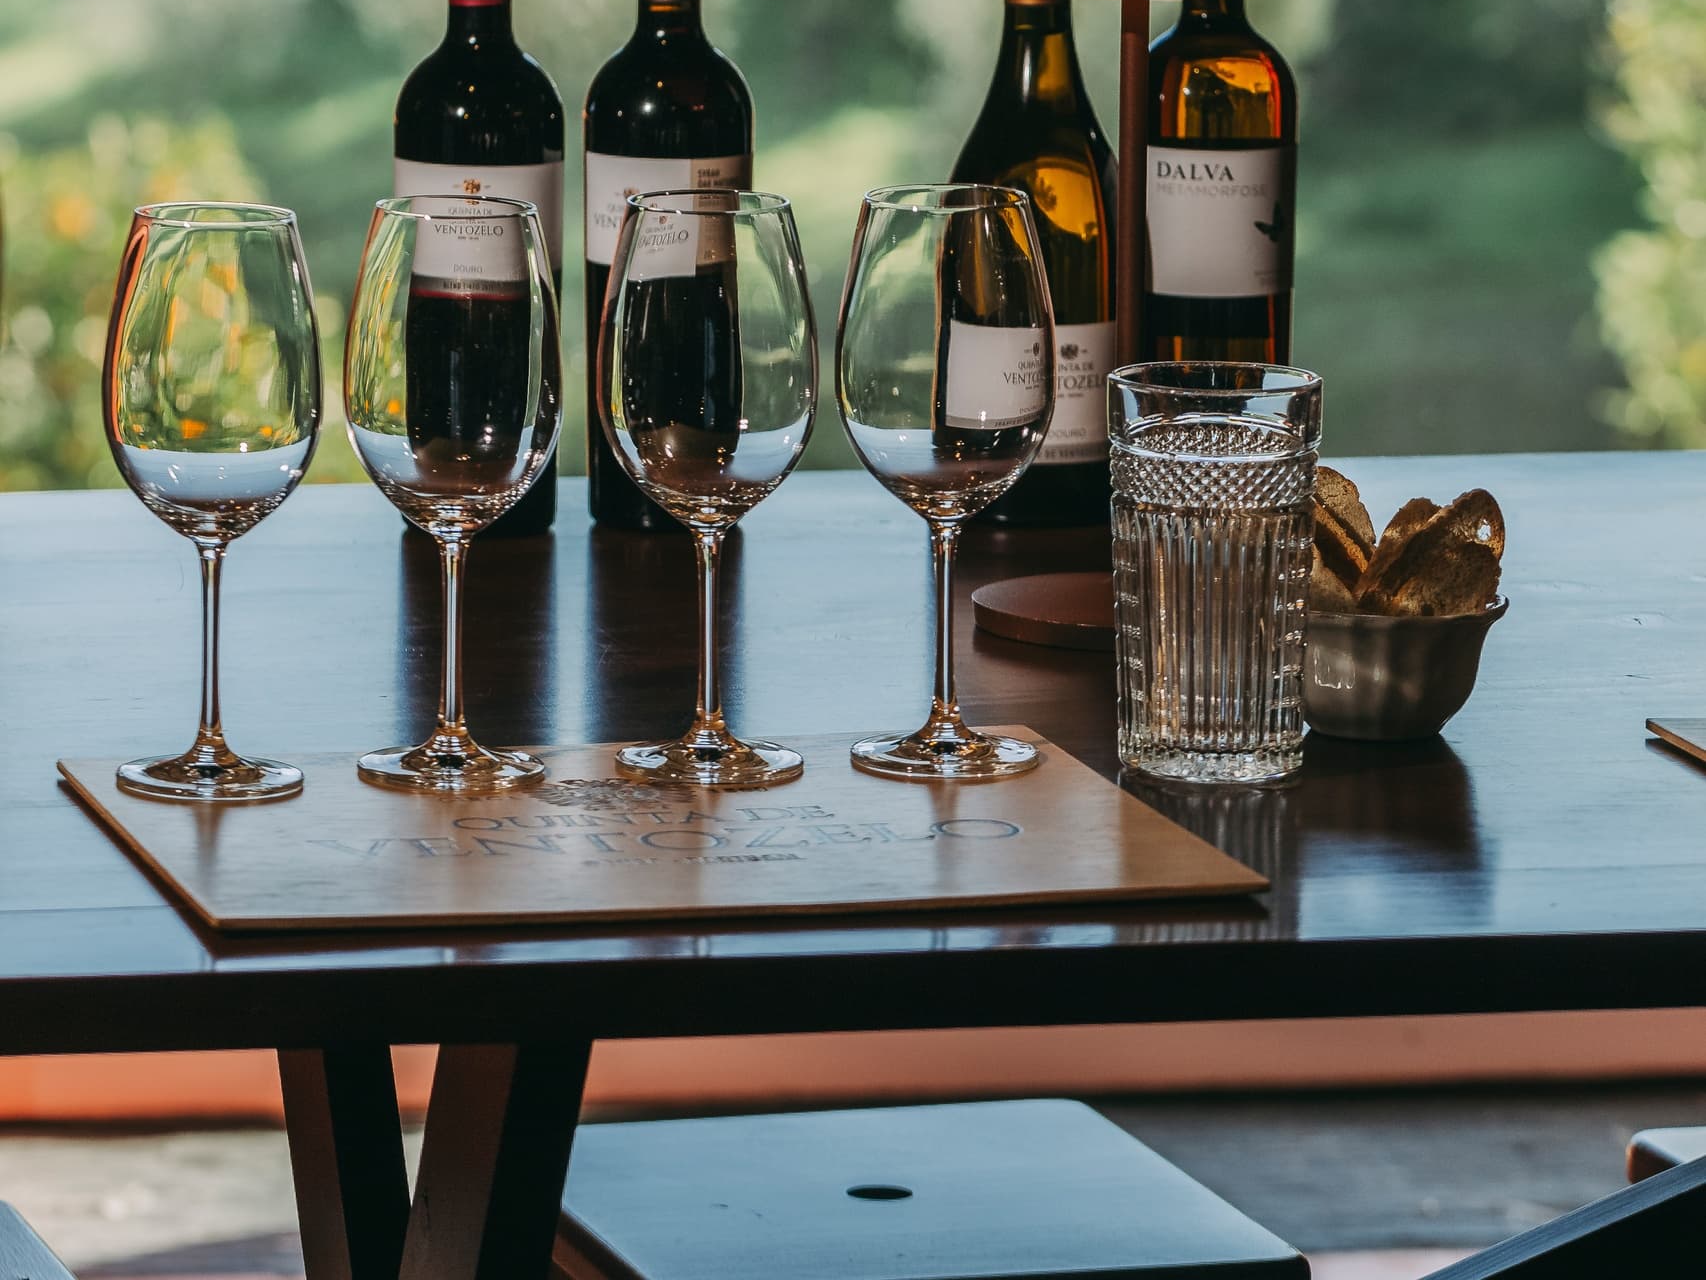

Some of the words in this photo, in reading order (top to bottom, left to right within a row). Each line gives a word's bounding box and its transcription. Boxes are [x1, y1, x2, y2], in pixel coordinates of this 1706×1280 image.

[1156, 160, 1234, 182] DALVA
[1156, 183, 1270, 199] METAMORFOSE
[434, 224, 504, 237] VENTOZELO
[452, 810, 722, 830] QUINTA
[735, 804, 835, 821] DE
[306, 819, 1024, 858] VENTOZELO
